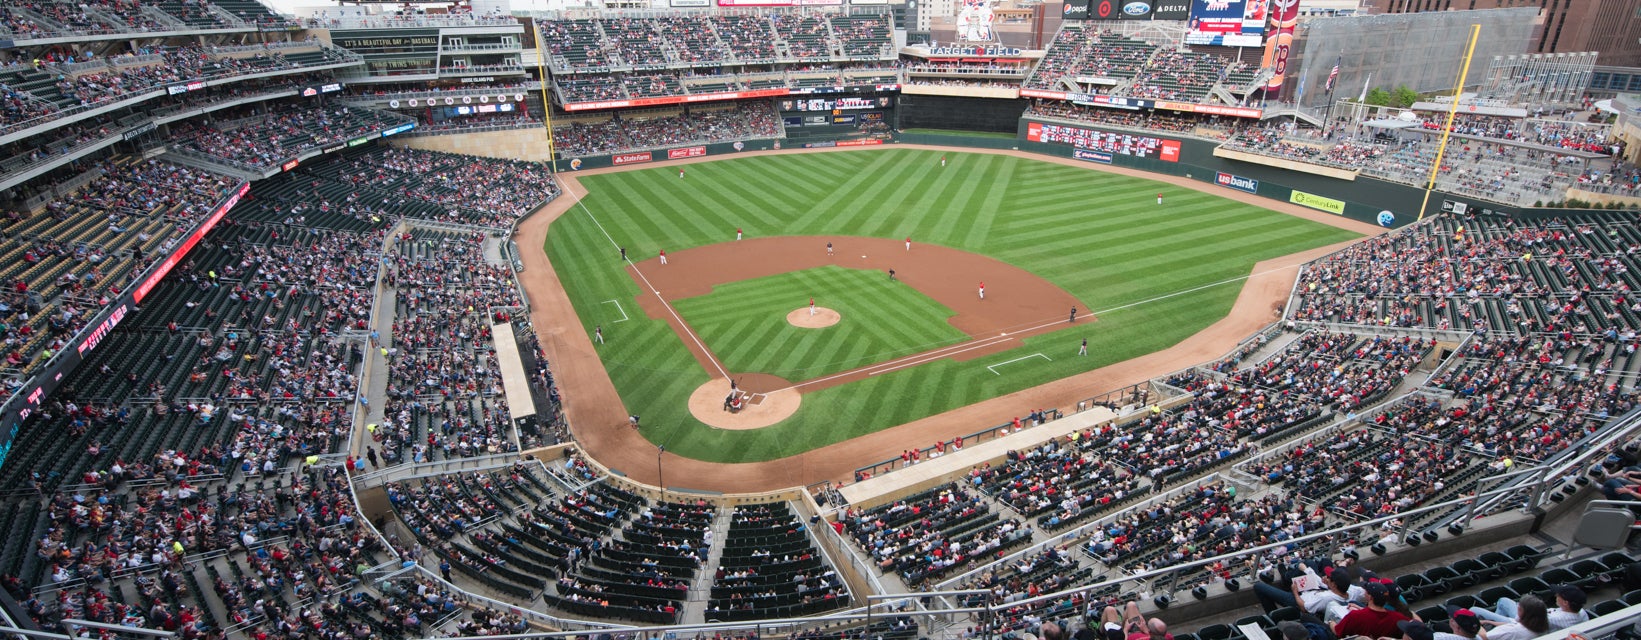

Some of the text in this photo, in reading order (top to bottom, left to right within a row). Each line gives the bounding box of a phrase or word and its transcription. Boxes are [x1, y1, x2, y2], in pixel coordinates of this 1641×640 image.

[1071, 4, 1087, 13] pepsi
[1129, 5, 1145, 13] Ford
[930, 47, 1021, 56] TARGET FIELD
[1305, 196, 1339, 210] CenturyLink
